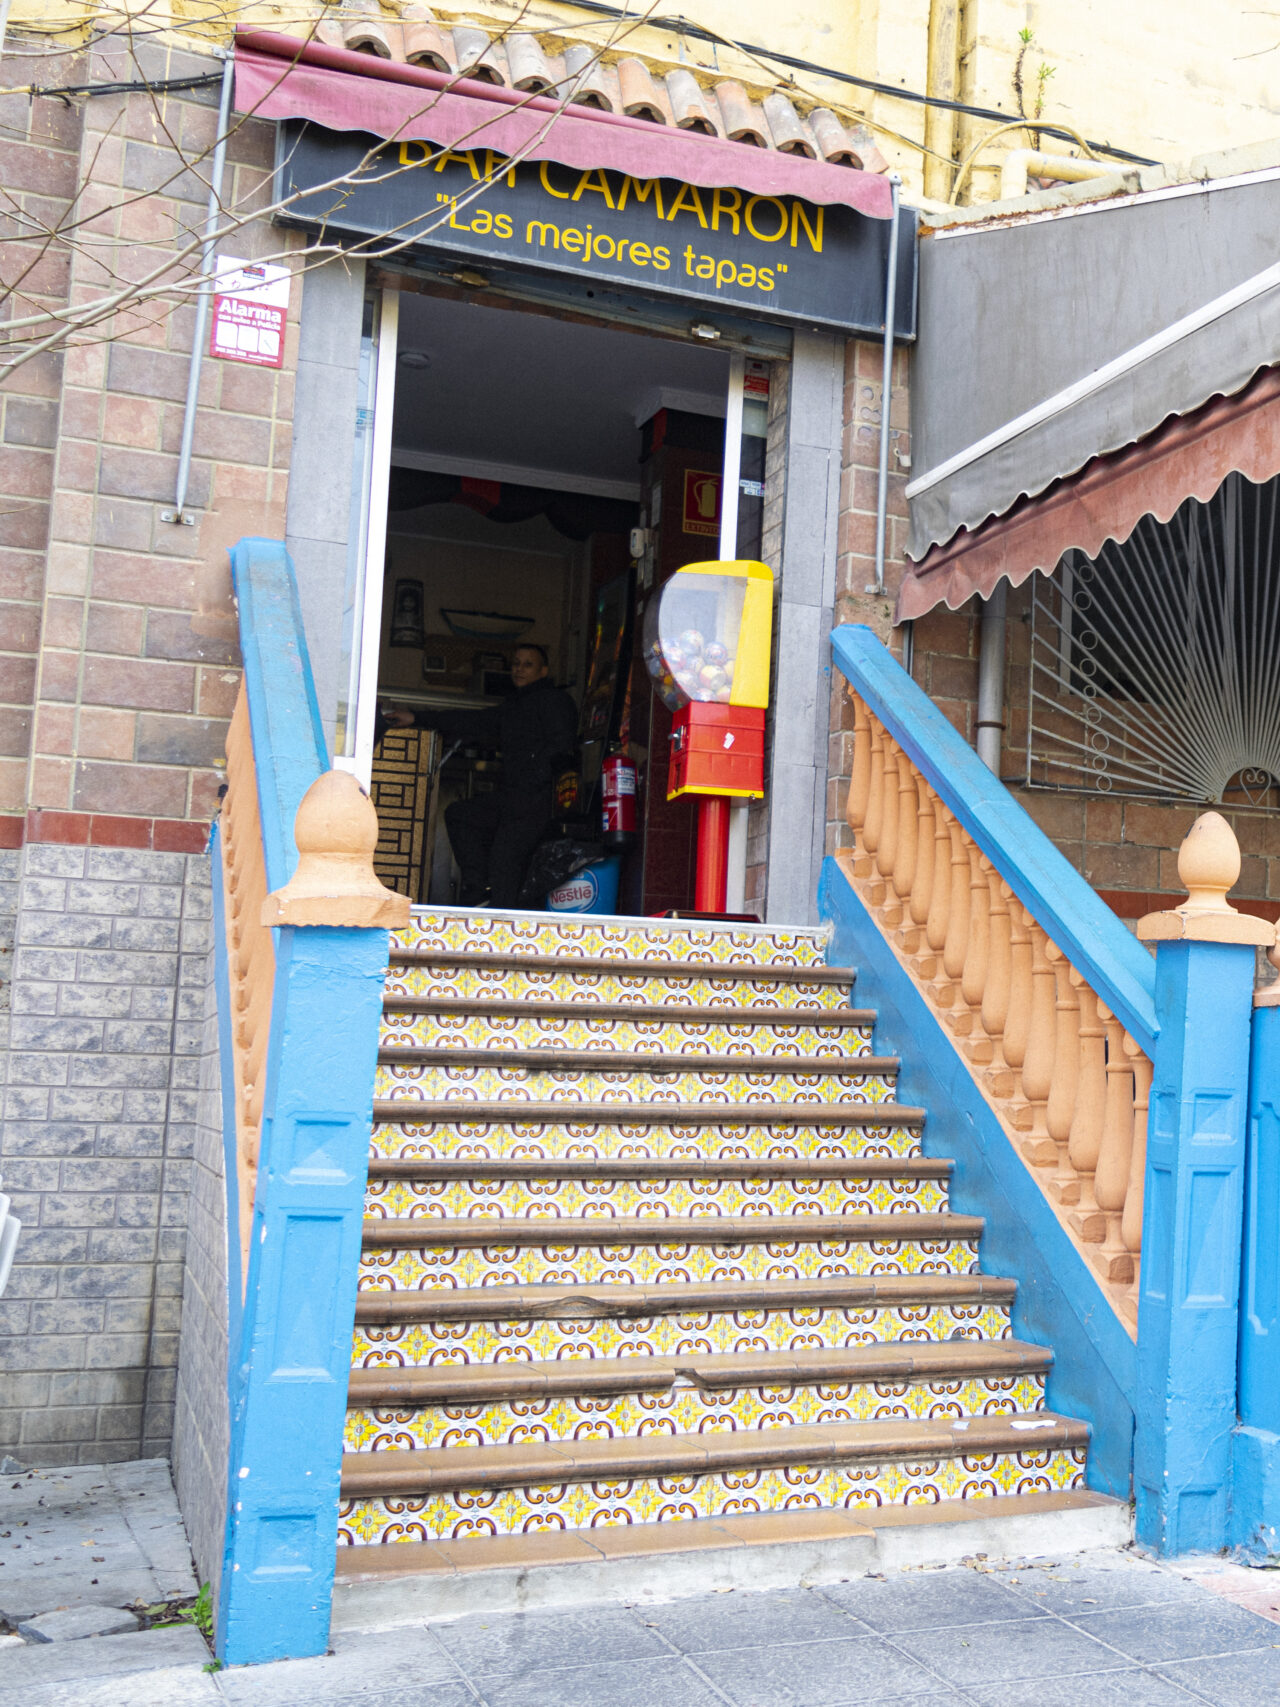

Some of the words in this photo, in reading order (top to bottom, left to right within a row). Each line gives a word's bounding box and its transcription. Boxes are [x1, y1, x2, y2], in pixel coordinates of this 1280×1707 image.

[436, 192, 513, 239] "Las
[526, 220, 671, 270] mejores
[684, 244, 790, 292] tapas"
[219, 299, 282, 324] Alarma
